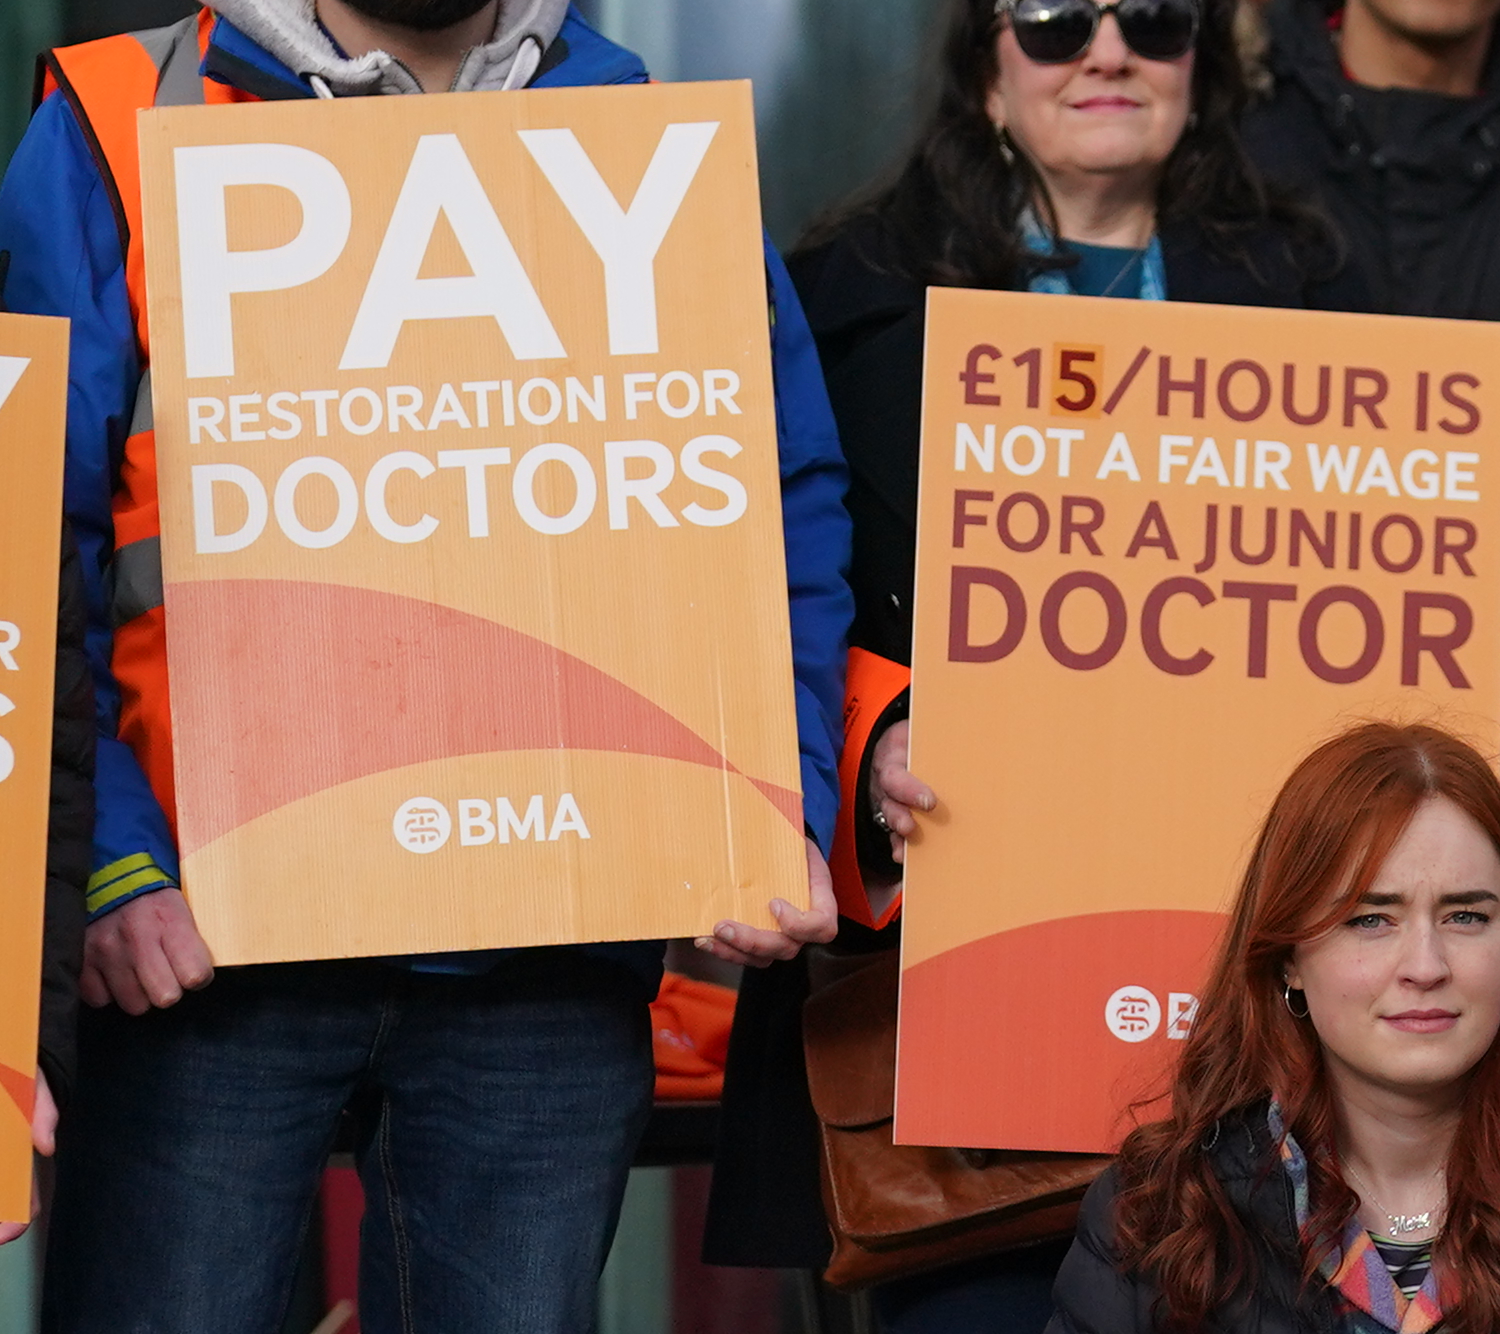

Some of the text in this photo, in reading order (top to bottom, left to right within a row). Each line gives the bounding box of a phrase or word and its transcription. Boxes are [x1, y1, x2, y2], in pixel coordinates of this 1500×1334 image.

[173, 121, 721, 379] PAY
[187, 368, 742, 444] RESTORATION FOR
[959, 344, 1481, 436] £15/HOUR IS
[192, 434, 748, 554] DOCTORS
[955, 422, 1480, 501] NOT A FAIR WAGE
[953, 489, 1479, 578] FOR A JUNIOR
[947, 566, 1475, 689] DOCTOR
[458, 792, 591, 847] BMA
